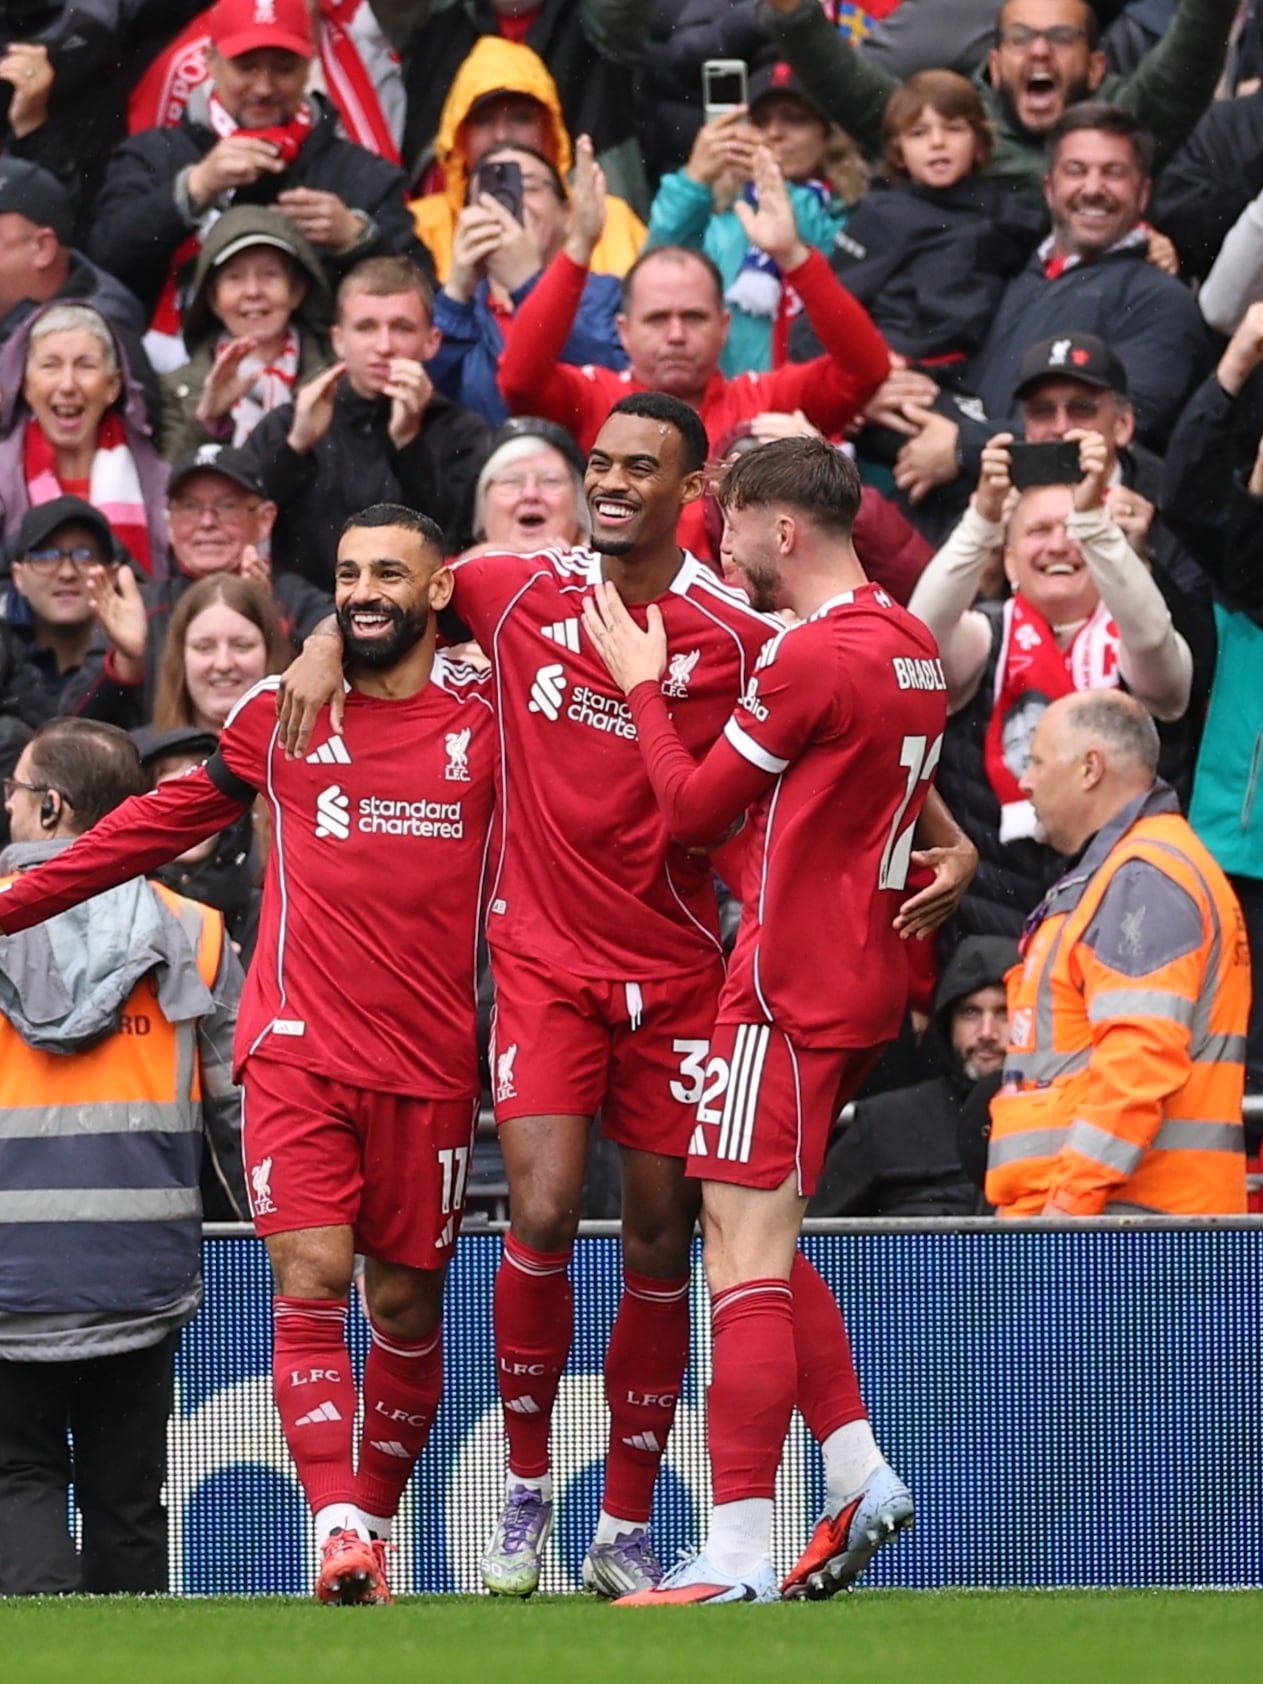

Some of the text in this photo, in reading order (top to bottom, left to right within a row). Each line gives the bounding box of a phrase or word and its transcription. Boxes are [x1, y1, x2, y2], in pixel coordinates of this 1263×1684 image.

[567, 704, 639, 741] charte
[359, 796, 461, 820] standard
[358, 815, 463, 839] chartered
[438, 1146, 468, 1214] 11
[291, 1368, 341, 1387] LFC
[500, 1358, 544, 1376] LFC
[626, 1391, 674, 1408] LFC
[374, 1401, 427, 1427] LFC
